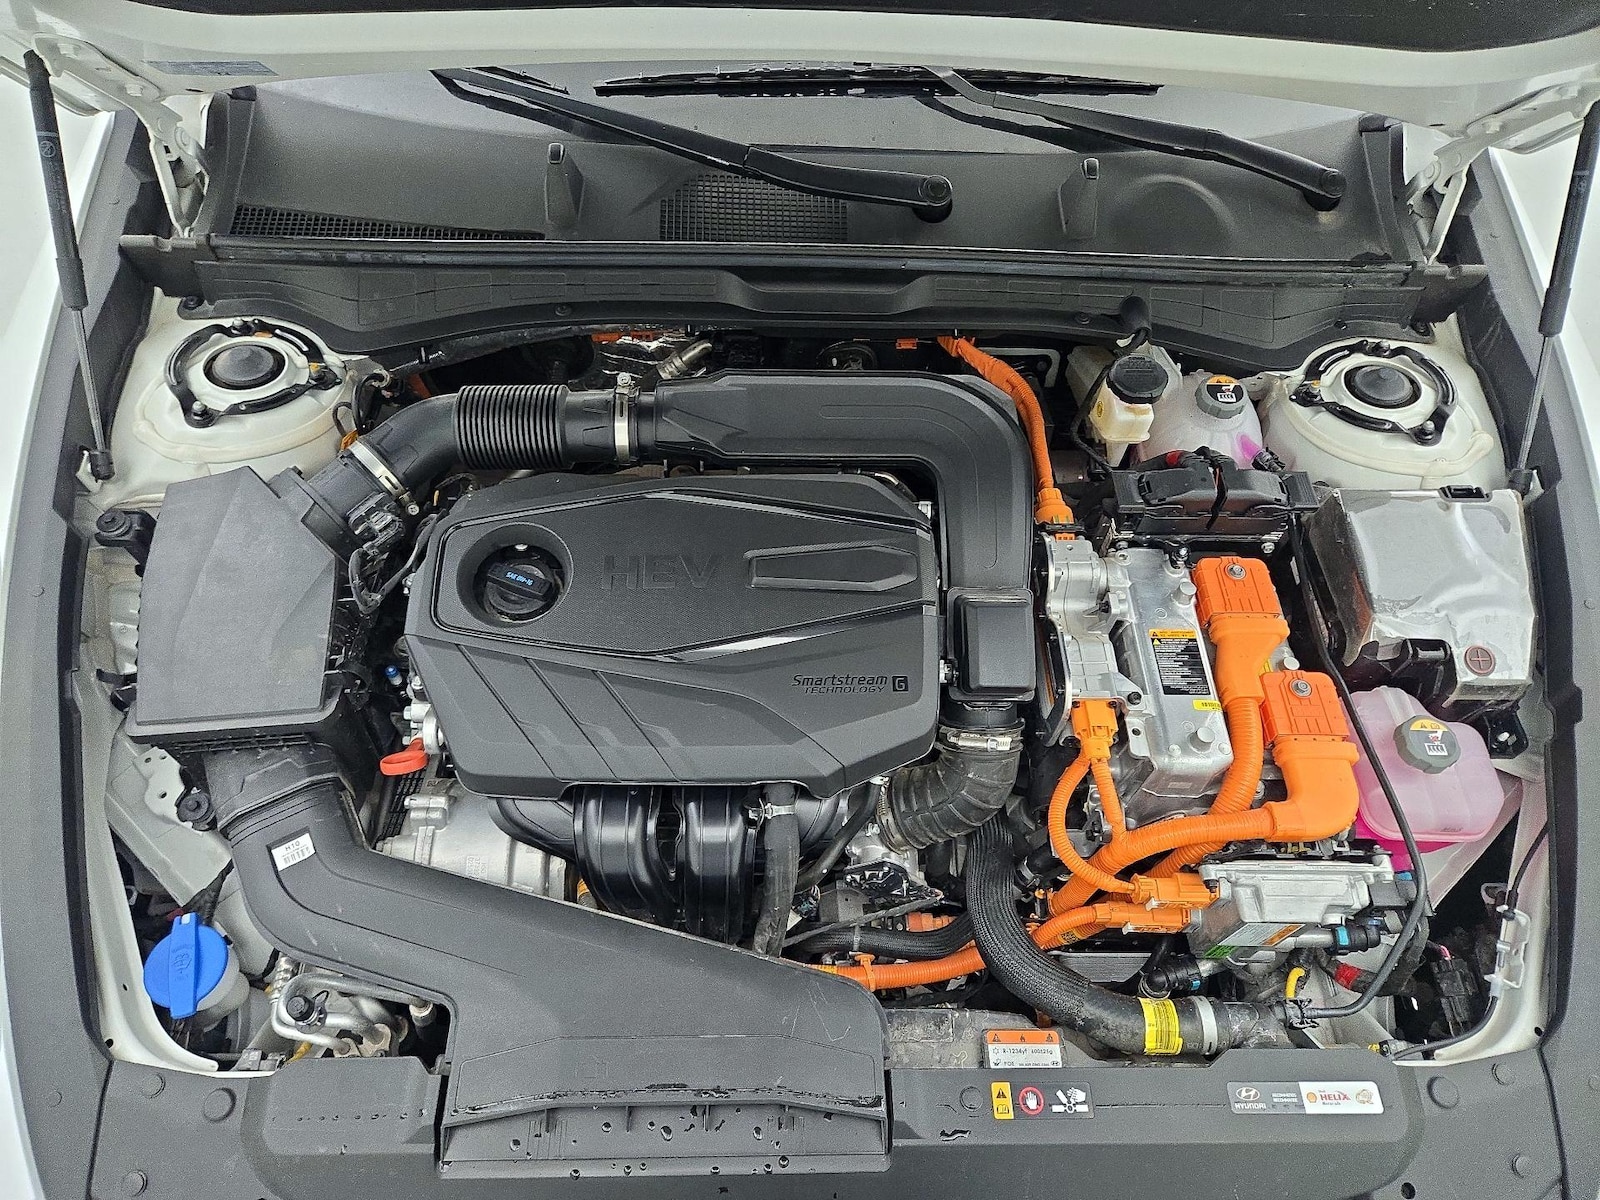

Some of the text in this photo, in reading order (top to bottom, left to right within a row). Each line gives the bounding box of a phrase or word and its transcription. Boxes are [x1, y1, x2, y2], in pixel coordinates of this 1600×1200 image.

[601, 554, 722, 589] HEV
[792, 674, 908, 691] Smartstream G
[804, 686, 885, 694] TECHNOLOGY
[1320, 1093, 1351, 1101] HELIX
[1234, 1102, 1267, 1110] HYUNDAI
